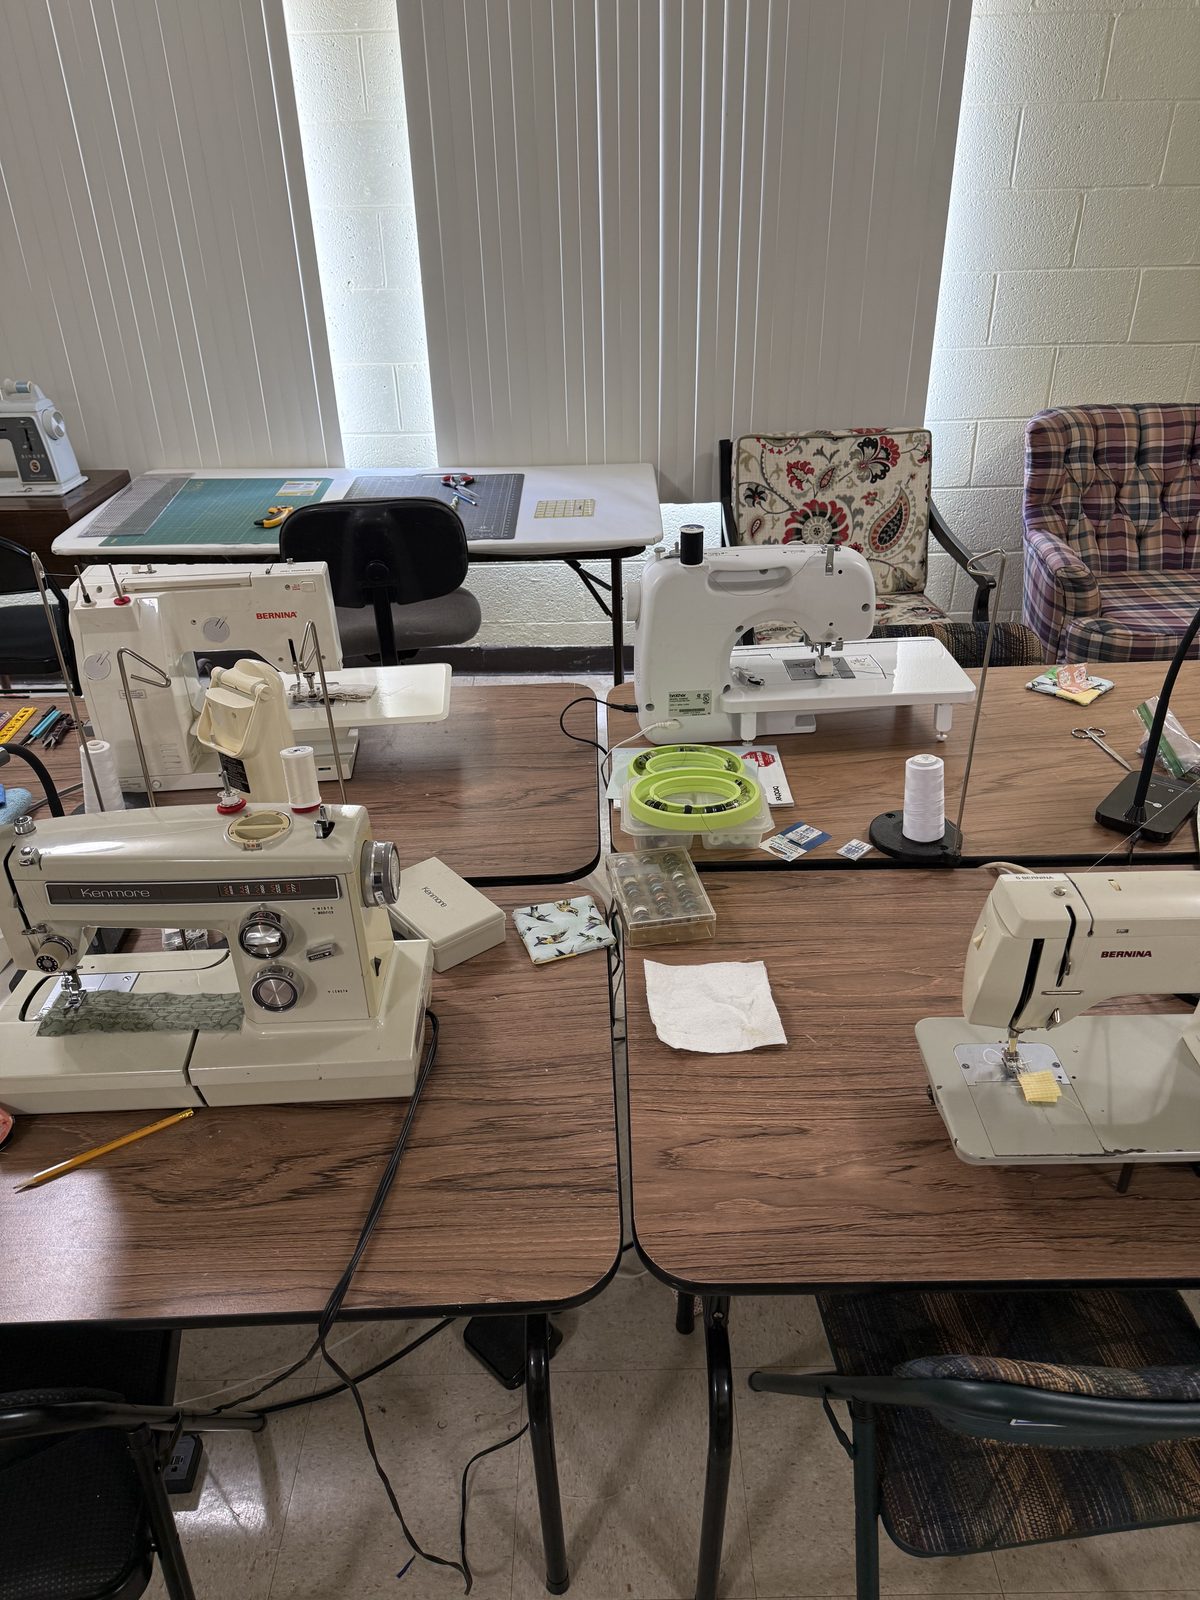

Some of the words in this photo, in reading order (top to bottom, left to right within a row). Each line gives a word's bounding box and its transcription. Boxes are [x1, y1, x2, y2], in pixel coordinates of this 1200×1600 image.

[256, 611, 298, 620] BERNINA
[772, 785, 783, 802] brother
[81, 888, 150, 898] Kenmore
[422, 886, 448, 908] Kenmore
[1101, 950, 1153, 959] BERNINA
